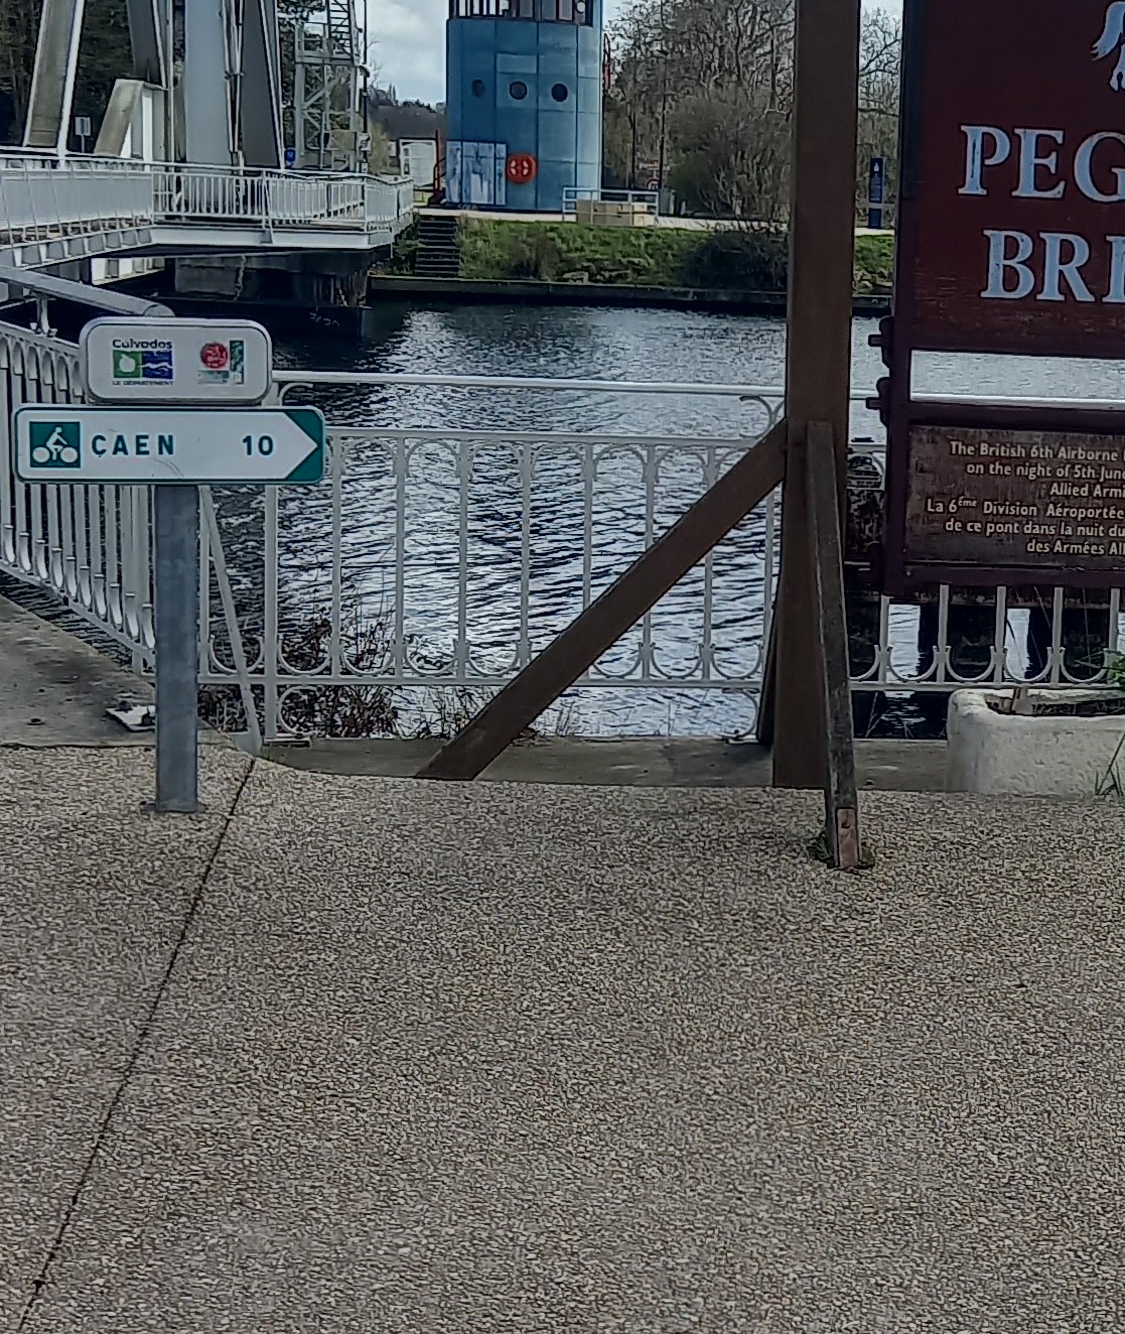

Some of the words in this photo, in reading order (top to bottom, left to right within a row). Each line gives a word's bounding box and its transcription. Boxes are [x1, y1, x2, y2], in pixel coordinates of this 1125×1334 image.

[112, 338, 173, 349] Calvados
[91, 434, 174, 456] CAEN
[242, 434, 274, 456] 10
[950, 440, 975, 456] The
[980, 442, 1026, 458] British
[1030, 444, 1053, 459] 6th
[1058, 446, 1119, 462] Airborne
[966, 463, 984, 475] on
[989, 460, 1012, 476] the
[1016, 462, 1052, 481] night
[1056, 464, 1071, 478] of
[1073, 464, 1096, 479] 5th
[1049, 481, 1089, 497] Allied
[926, 498, 944, 513] La
[983, 501, 1038, 516] Division
[1046, 503, 1125, 522] Aéroportée
[945, 517, 962, 532] de
[966, 521, 982, 533] ce
[986, 522, 1020, 537] pont
[1023, 521, 1057, 536] dans
[1060, 522, 1073, 536] la
[1077, 524, 1105, 538] nuit
[1026, 538, 1050, 554] des
[1053, 540, 1105, 556] Armées
